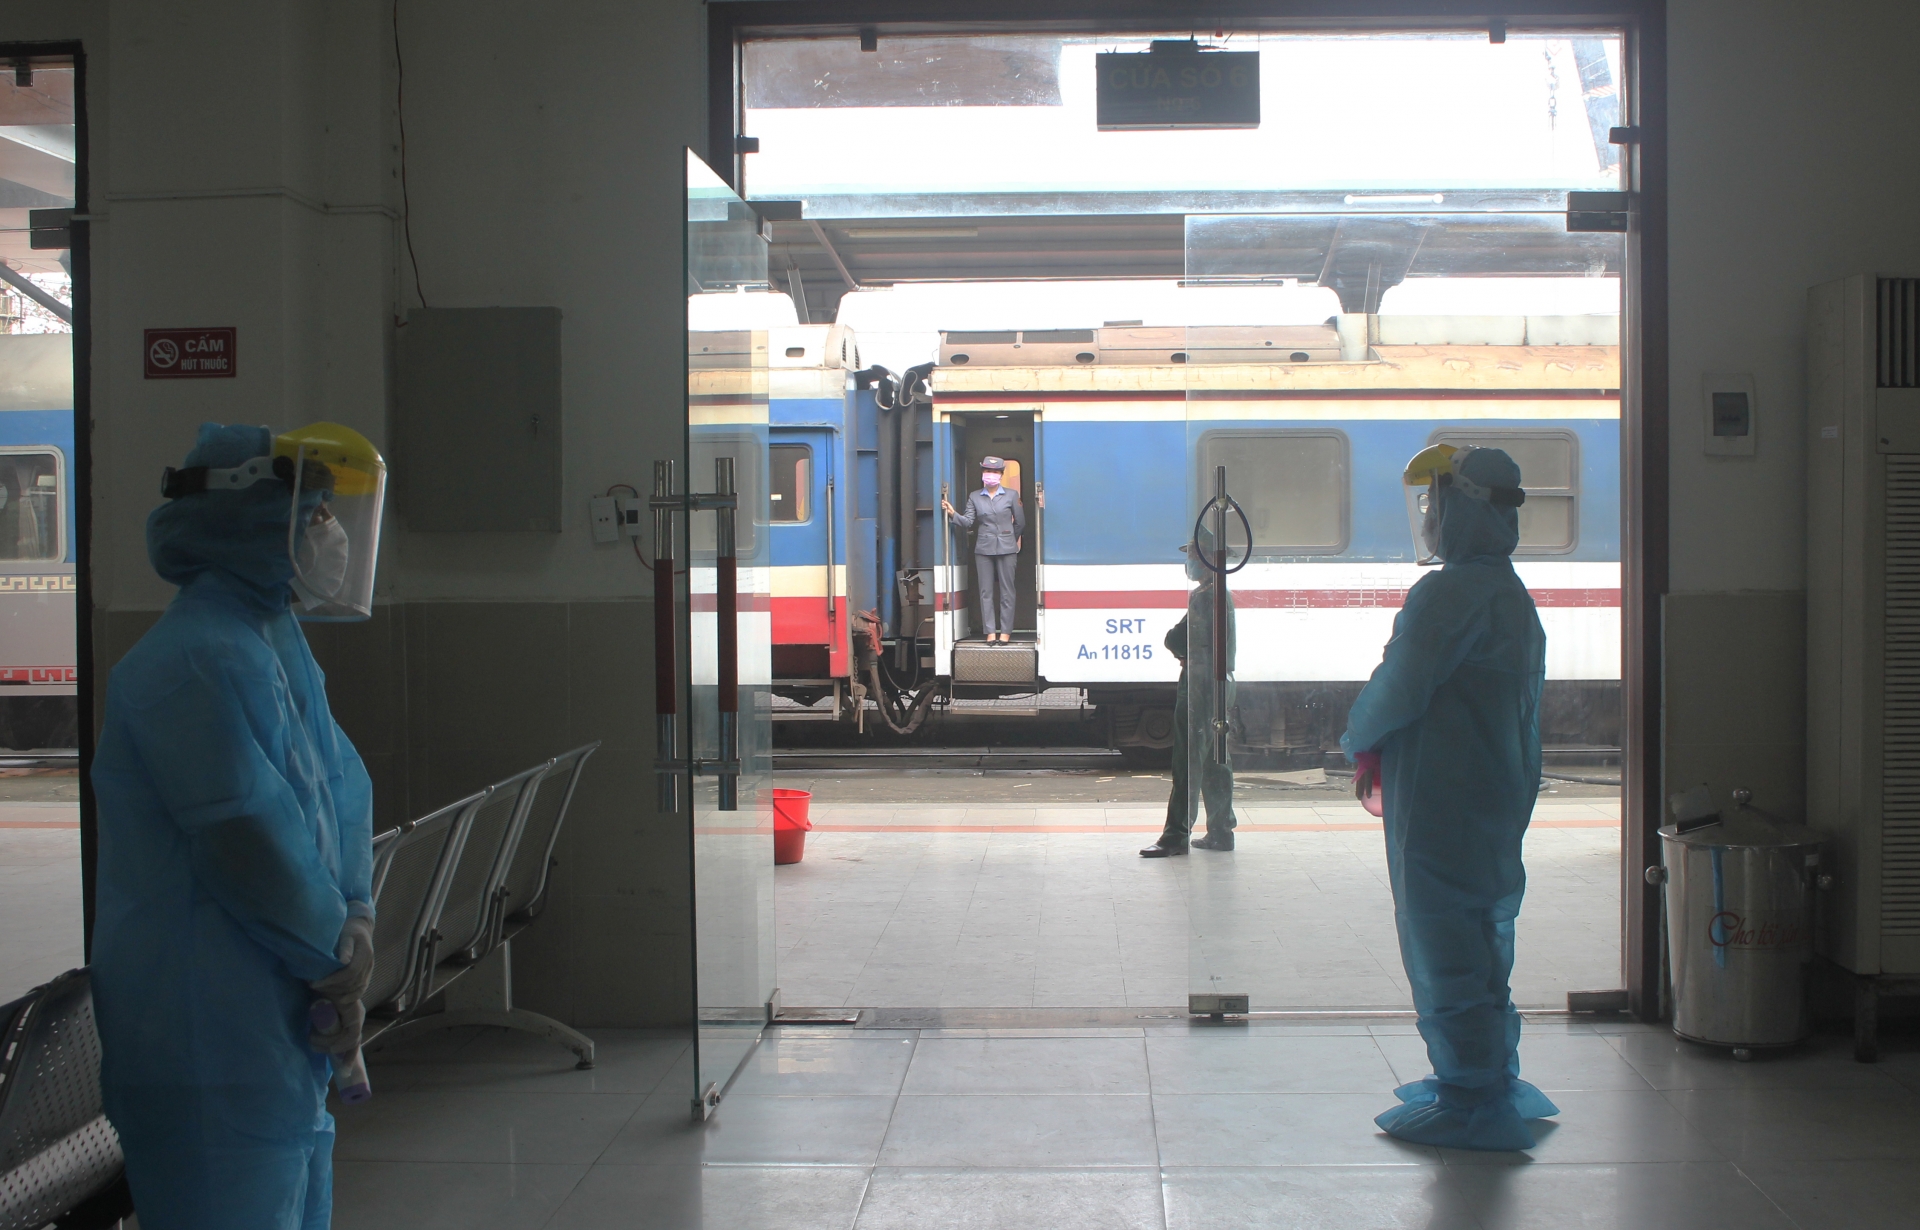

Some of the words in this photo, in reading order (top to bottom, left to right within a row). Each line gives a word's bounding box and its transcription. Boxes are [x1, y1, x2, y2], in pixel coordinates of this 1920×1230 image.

[1109, 61, 1172, 90] CỬA
[1180, 59, 1222, 88] SỐ
[1229, 65, 1248, 88] 6
[184, 333, 224, 353] CẤM
[181, 356, 198, 370] HÚT
[200, 354, 228, 370] THUỐC
[1105, 618, 1146, 634] SRT
[1077, 643, 1098, 660] An
[1101, 644, 1153, 660] 11815
[1708, 911, 1755, 947] Cho
